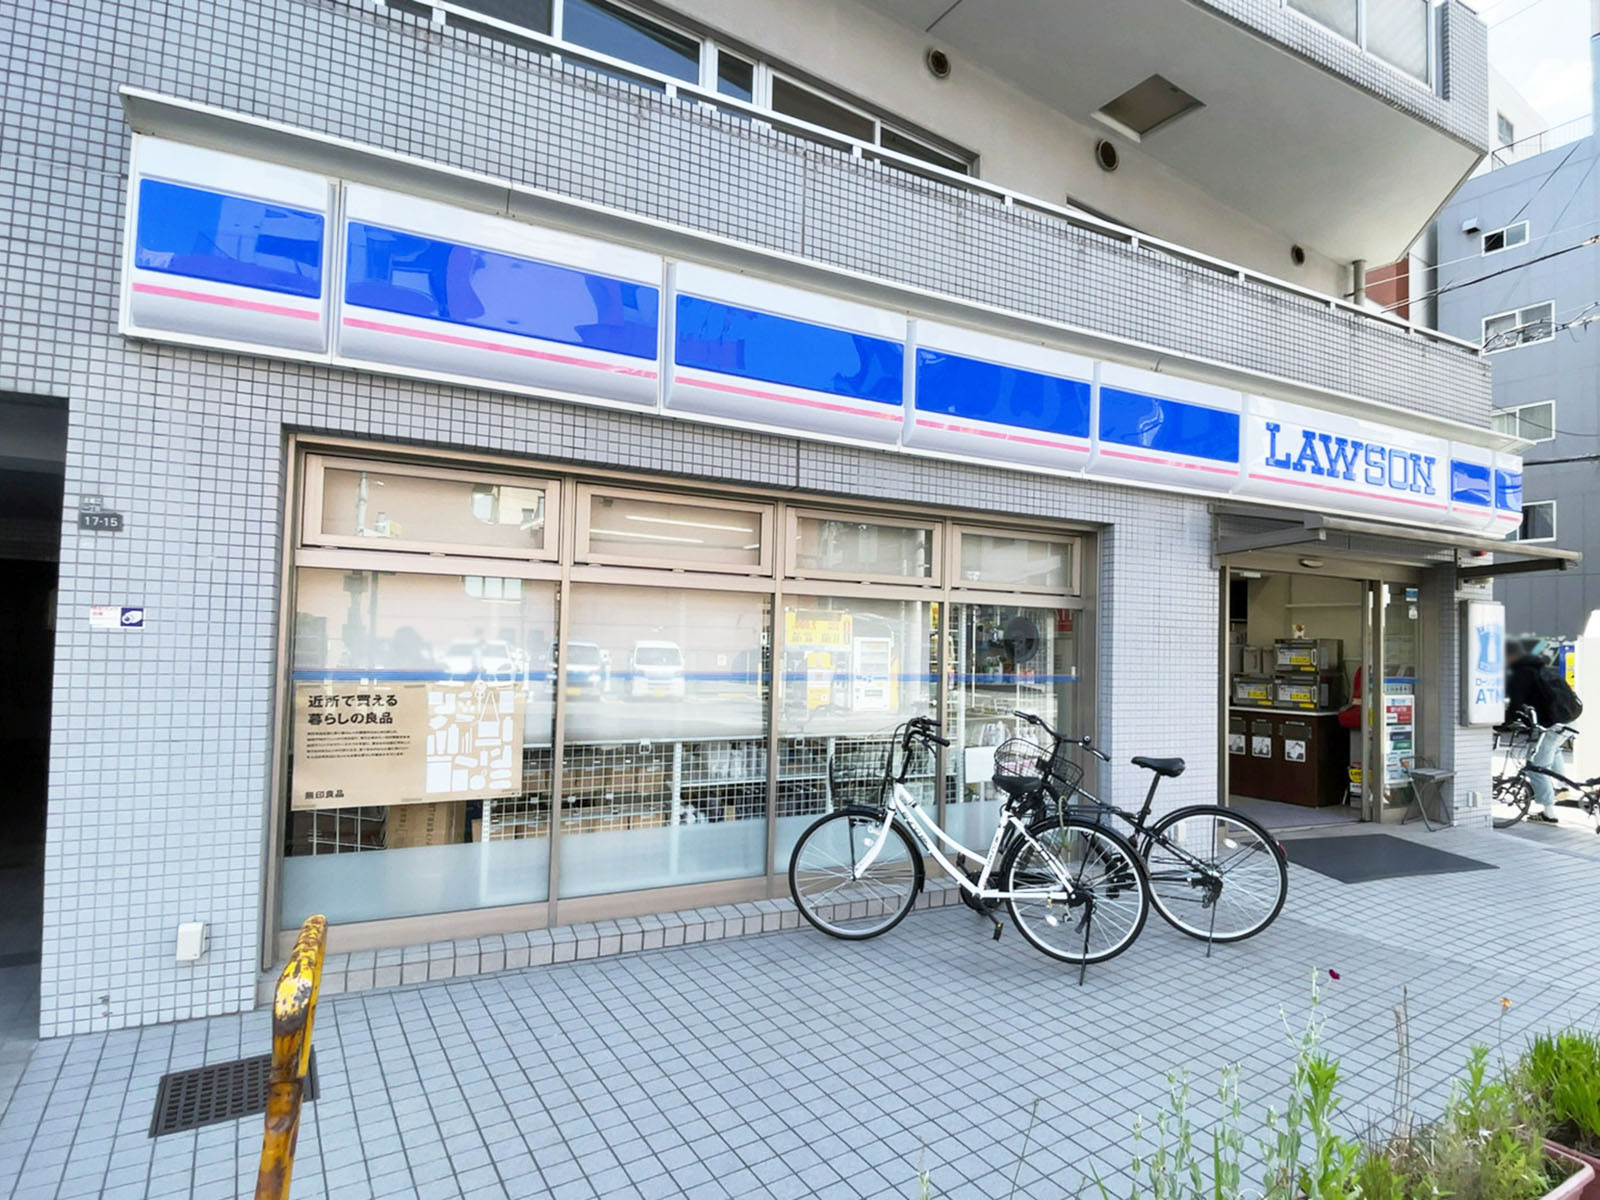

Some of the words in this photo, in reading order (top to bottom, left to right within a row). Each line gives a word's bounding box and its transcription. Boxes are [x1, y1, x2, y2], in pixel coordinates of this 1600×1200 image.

[1265, 421, 1436, 495] LAWSON
[84, 516, 118, 527] 17-15
[308, 694, 398, 708] 近所で買える
[308, 712, 393, 725] 暮らしの良品
[305, 789, 344, 800] 無印良品
